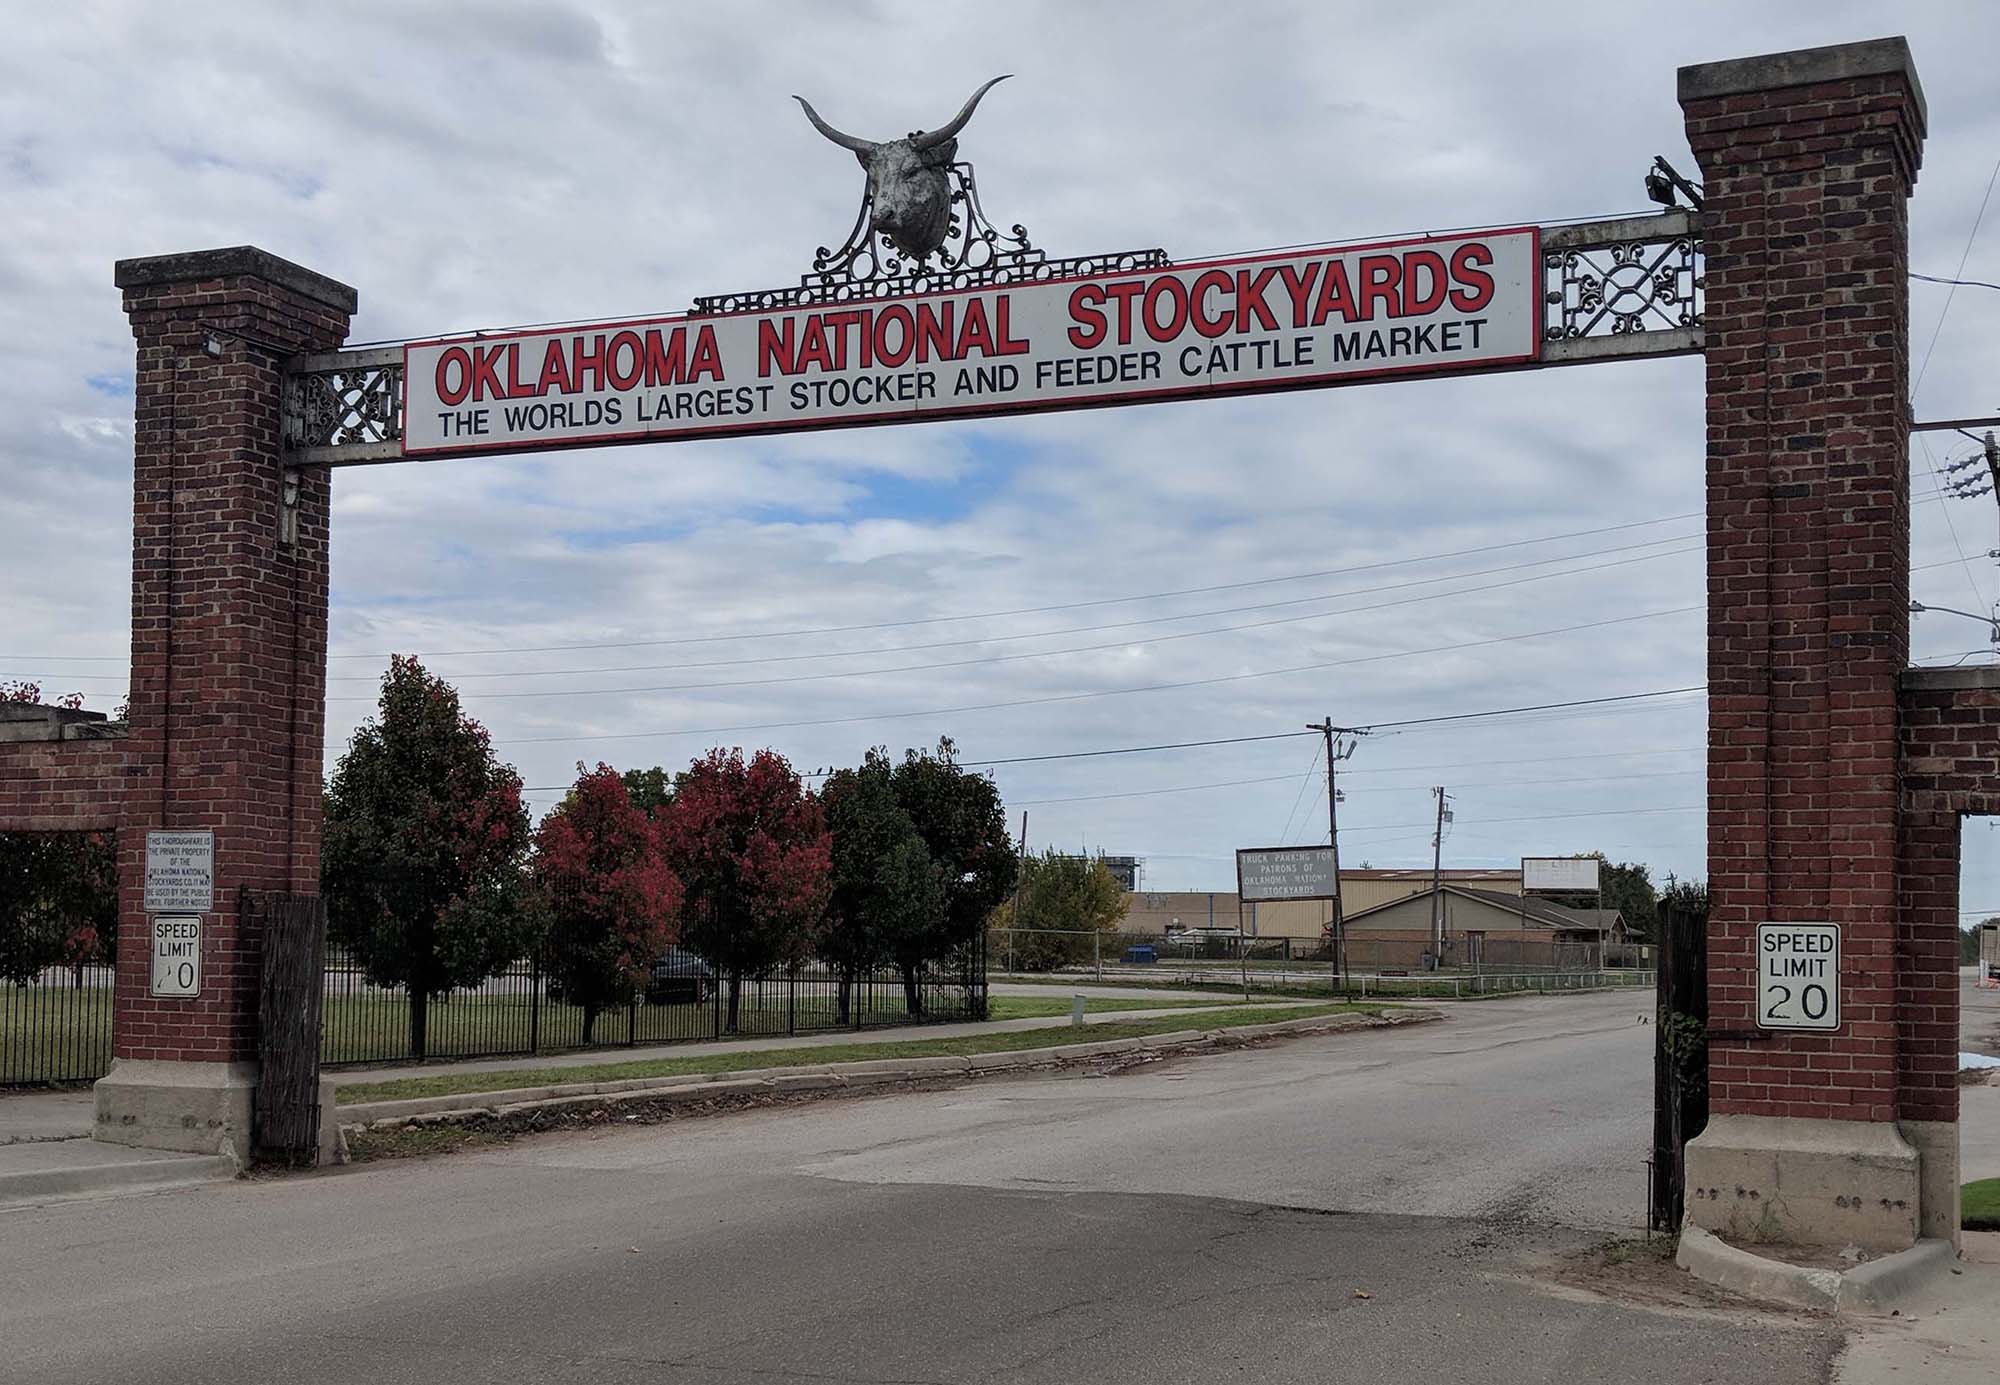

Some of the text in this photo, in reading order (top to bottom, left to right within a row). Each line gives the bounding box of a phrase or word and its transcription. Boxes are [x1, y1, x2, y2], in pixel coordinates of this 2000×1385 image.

[435, 243, 1496, 406] OKLAHOMA NATIONAL STOCKYARDS
[438, 319, 1489, 438] THE WORLDS LARGEST STOCKER AND FEEDER CATTLE MARKET
[160, 848, 180, 856] PRIVATE
[181, 848, 210, 857] PROPERTY
[1242, 851, 1333, 864] TRUCK PARKING FOR
[1260, 865, 1297, 873] PATRONS
[1244, 875, 1287, 886] OKLAHOMA
[1263, 886, 1315, 896] STOCKYARDS
[156, 924, 198, 938] SPEED
[160, 942, 194, 957] LIMIT
[1764, 933, 1833, 952] SPEED
[1770, 958, 1827, 977] LIMIT
[157, 962, 194, 989] 0
[1767, 984, 1828, 1020] 20
